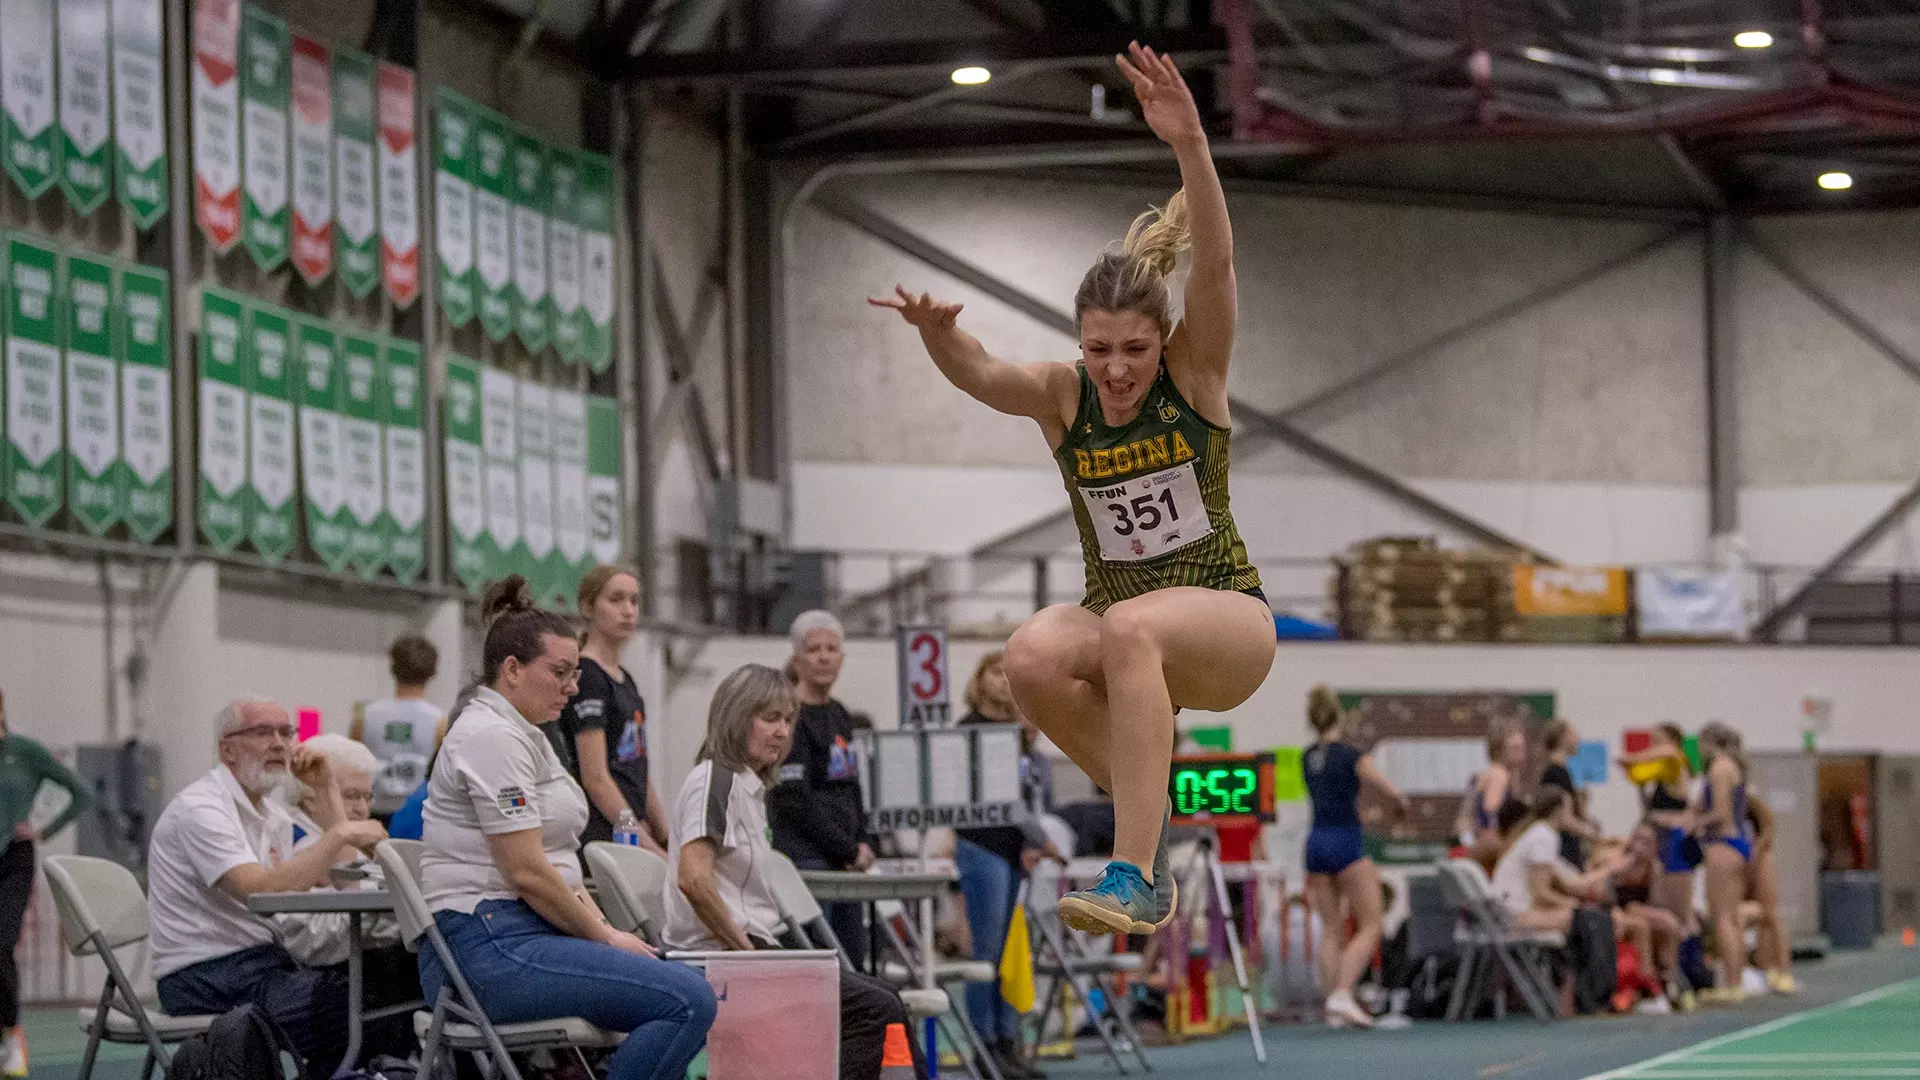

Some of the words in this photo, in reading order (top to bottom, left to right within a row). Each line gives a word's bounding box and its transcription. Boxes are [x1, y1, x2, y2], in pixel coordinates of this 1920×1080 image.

[1075, 430, 1195, 479] REGINA
[1088, 485, 1128, 500] FFUN
[1107, 487, 1179, 536] 351
[911, 633, 942, 699] 3
[909, 703, 949, 722] ATT
[1176, 768, 1257, 814] 0:52
